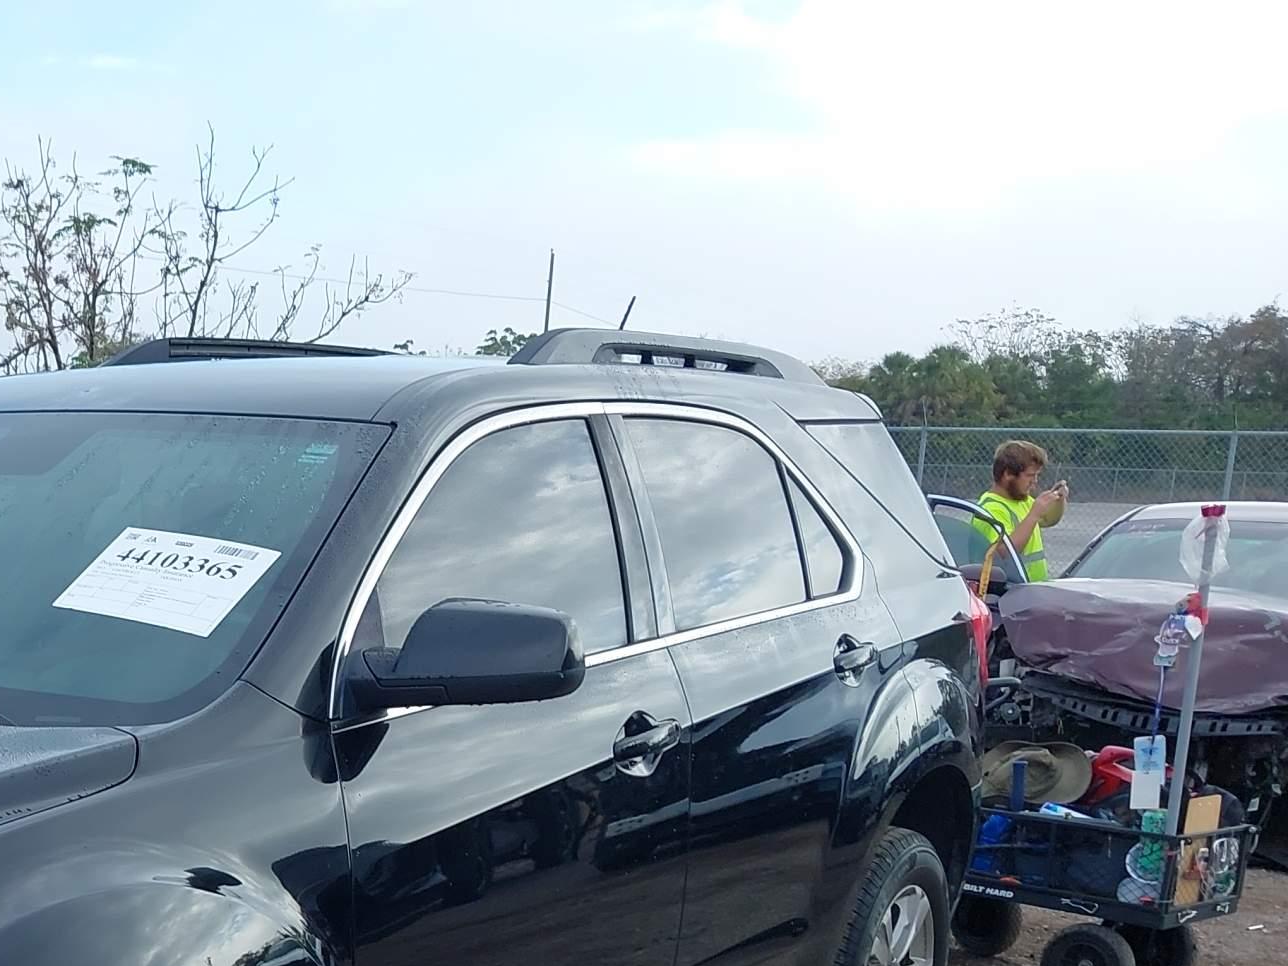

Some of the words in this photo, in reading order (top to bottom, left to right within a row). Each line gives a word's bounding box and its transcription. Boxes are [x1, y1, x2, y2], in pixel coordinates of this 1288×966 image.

[116, 547, 243, 580] 44103365
[963, 883, 985, 892] BILT
[985, 887, 1014, 897] HARD
